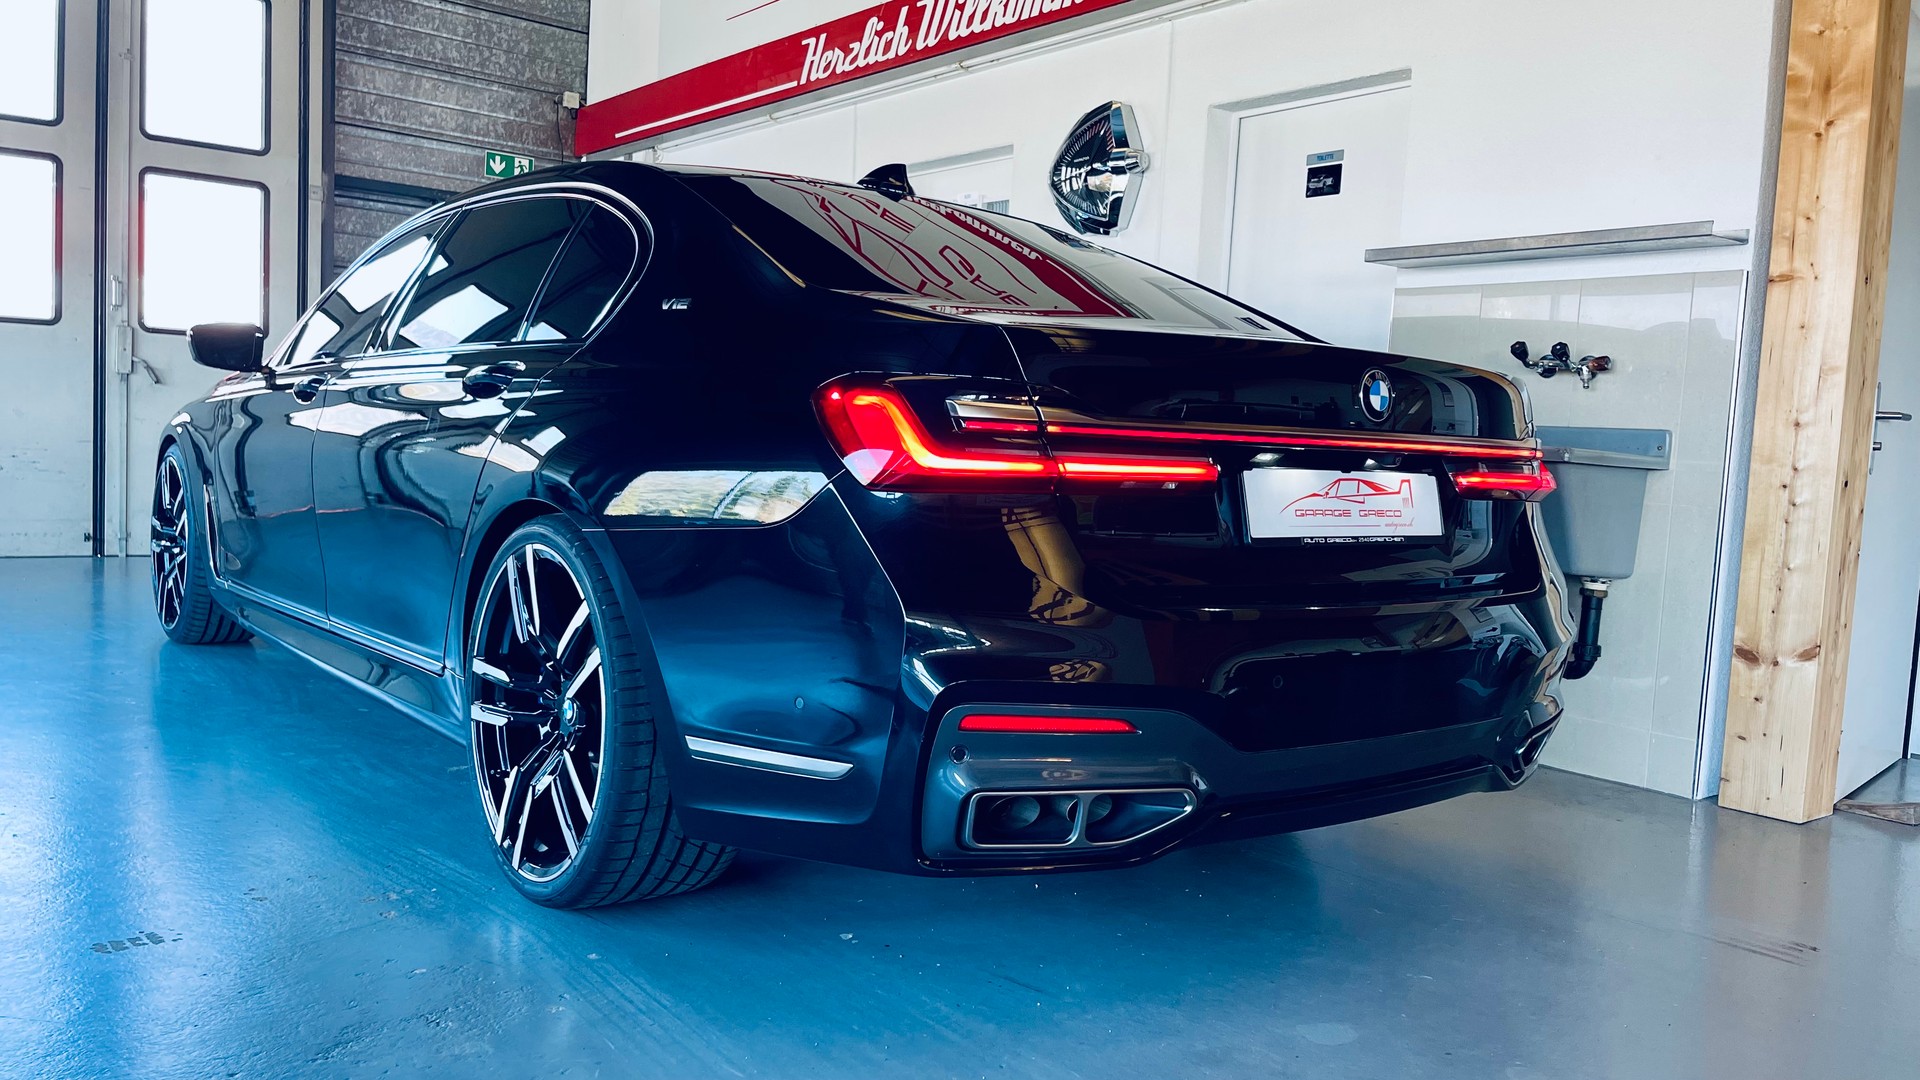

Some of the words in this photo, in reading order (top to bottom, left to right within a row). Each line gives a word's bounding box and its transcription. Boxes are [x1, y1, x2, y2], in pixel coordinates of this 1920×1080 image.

[800, 5, 914, 85] Herzlich
[662, 298, 691, 310] V12
[1294, 508, 1352, 518] GARAGE
[1358, 509, 1403, 518] GRECO
